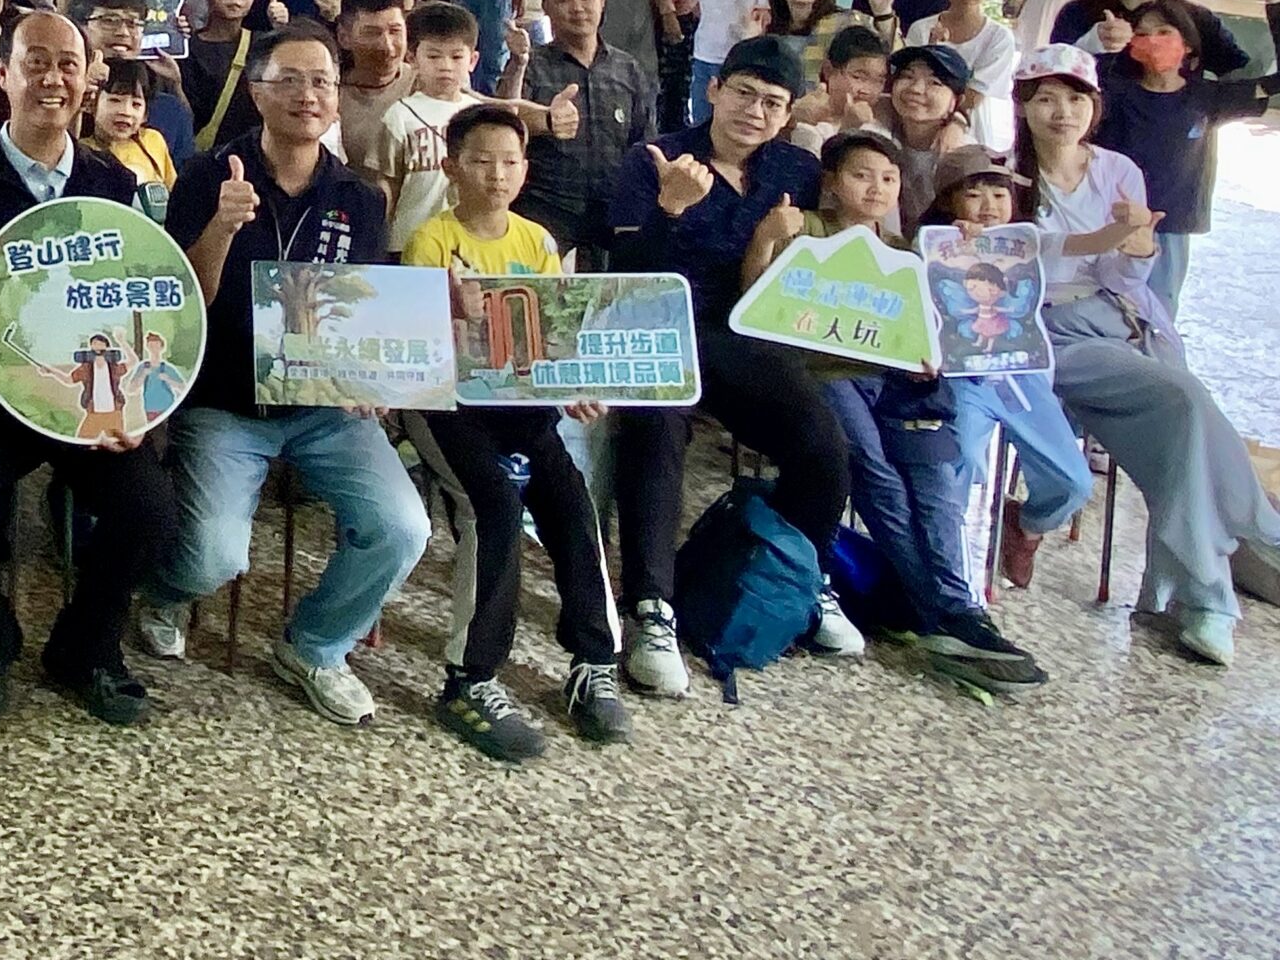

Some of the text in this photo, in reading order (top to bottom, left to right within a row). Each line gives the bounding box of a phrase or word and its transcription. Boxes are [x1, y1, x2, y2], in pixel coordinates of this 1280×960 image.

[7, 232, 121, 272] 登山健行
[66, 279, 182, 310] 旅遊景點
[579, 331, 680, 355] 提升步道
